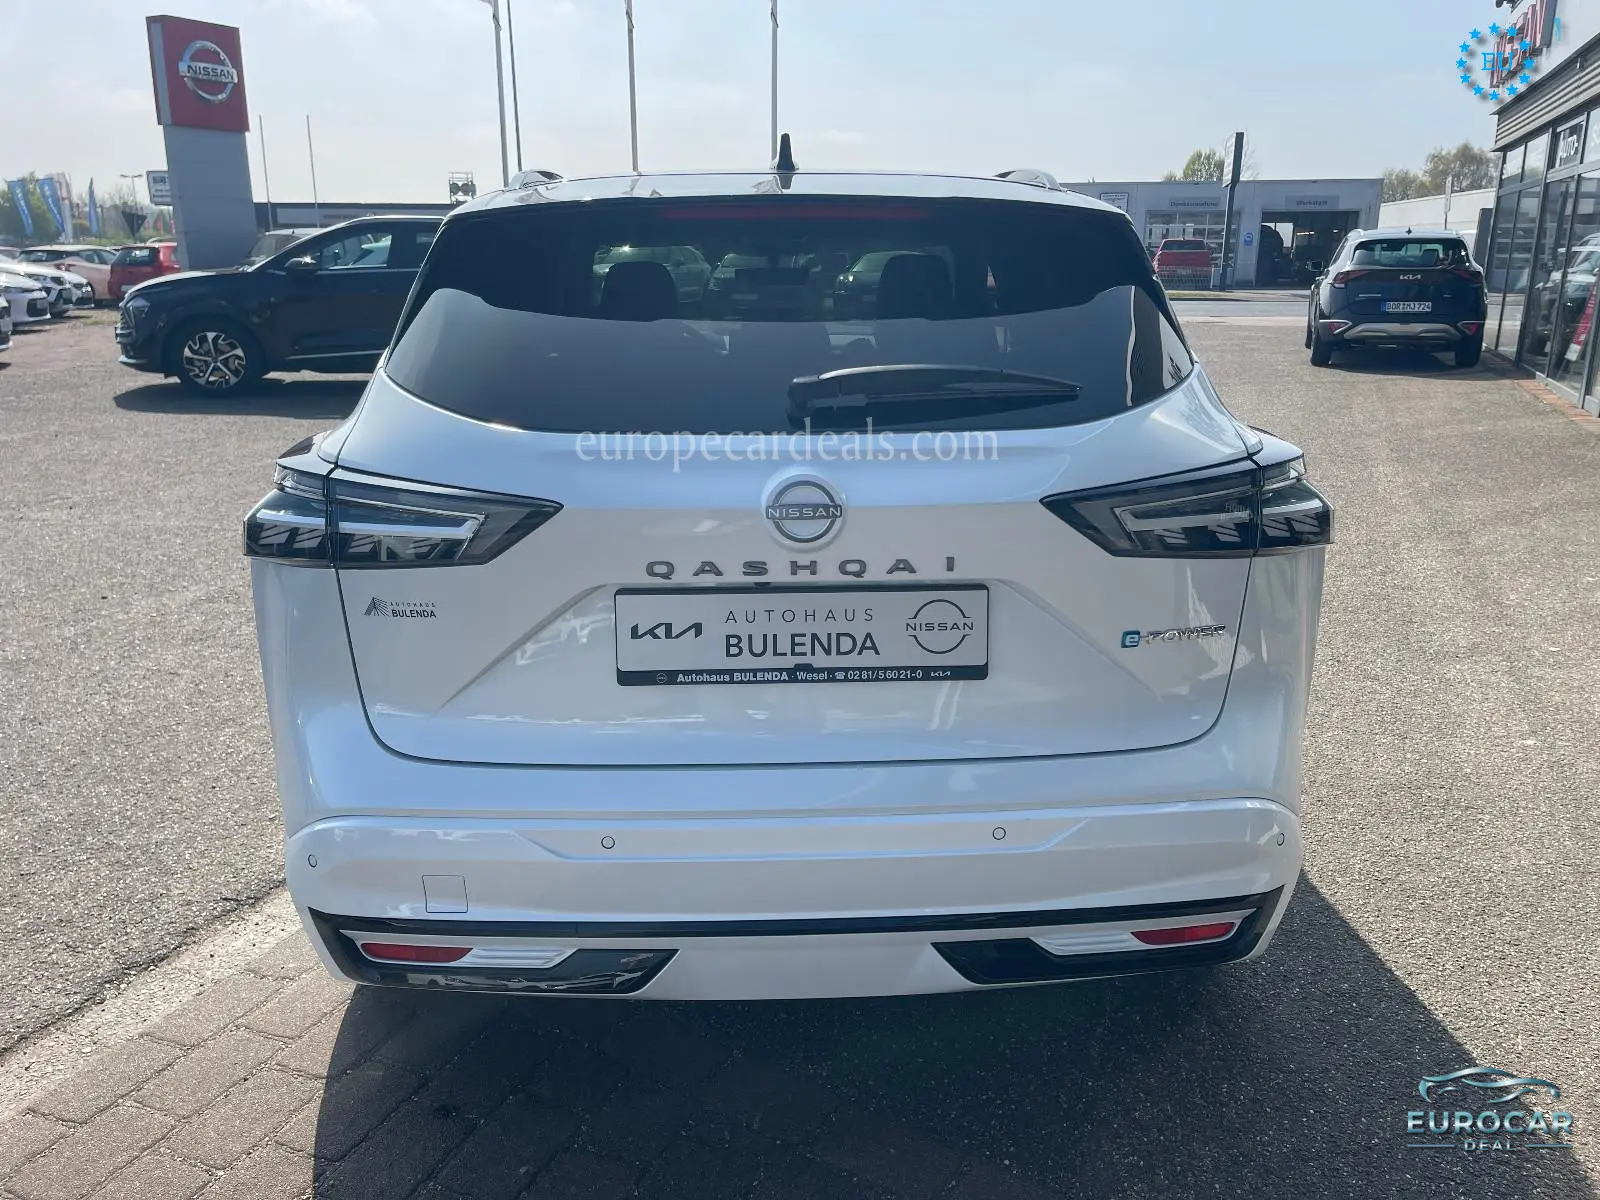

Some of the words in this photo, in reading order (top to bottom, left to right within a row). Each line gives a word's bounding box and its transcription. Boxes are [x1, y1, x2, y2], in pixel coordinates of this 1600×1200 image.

[187, 64, 234, 81] NISSAN
[767, 506, 841, 518] NISSAN
[645, 555, 956, 580] QASHQAI
[391, 609, 437, 618] BULENDA
[724, 608, 874, 624] AUTOHAUS
[905, 621, 975, 632] NISSAN
[725, 632, 881, 658] BULENDA
[676, 672, 730, 683] Autohaus
[733, 671, 789, 682] BULENDA
[796, 671, 828, 681] Wesel
